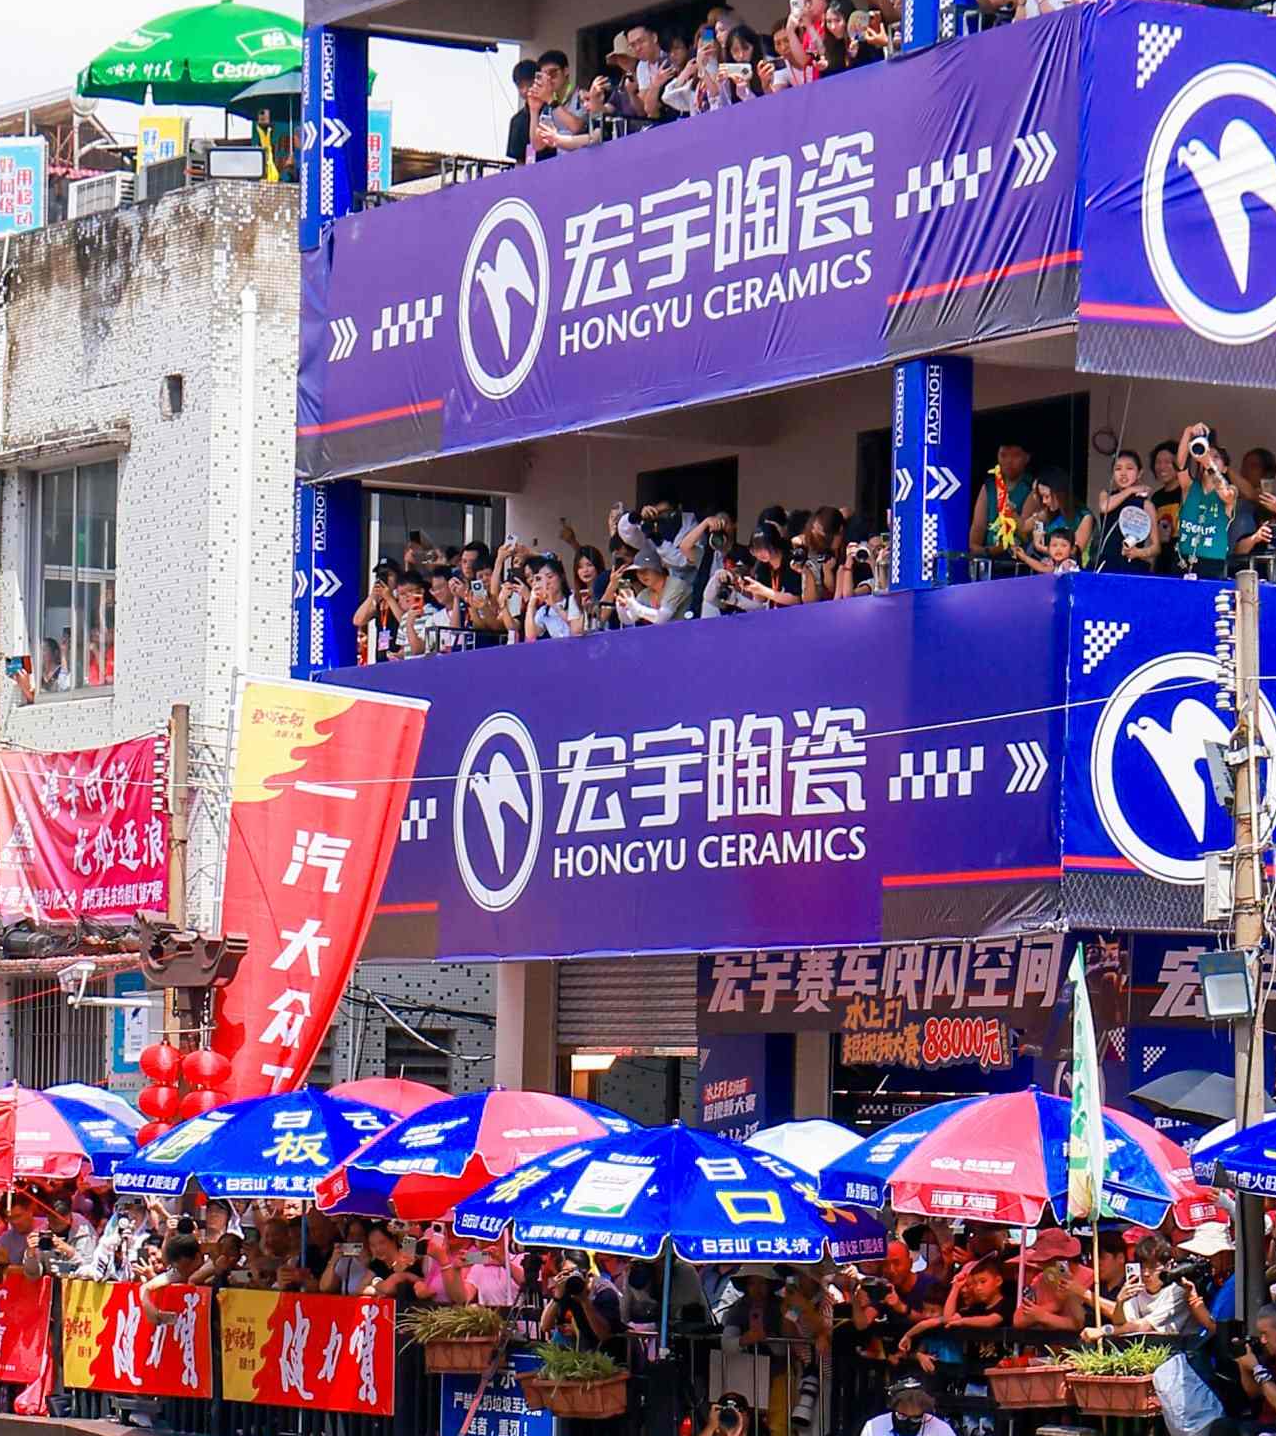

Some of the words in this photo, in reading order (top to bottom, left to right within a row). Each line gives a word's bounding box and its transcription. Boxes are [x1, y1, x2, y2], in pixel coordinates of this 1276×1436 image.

[321, 31, 335, 102] HONGYU
[561, 131, 875, 311] 宏宇陶瓷
[558, 292, 692, 357] HONGYU
[702, 248, 873, 322] CERAMICS
[927, 363, 941, 446] HONGYU
[555, 706, 868, 836] 宏宇陶瓷
[552, 835, 686, 879] HONGYU
[697, 825, 867, 870] CERAMICS
[707, 933, 1065, 1013] 宏宇赛车快闪空间
[842, 1020, 921, 1069] 短视频大赛
[922, 1015, 1004, 1068] 88000元
[225, 1178, 268, 1192] 白云山
[701, 1238, 753, 1254] 白云山
[757, 1238, 812, 1255] 口炎清
